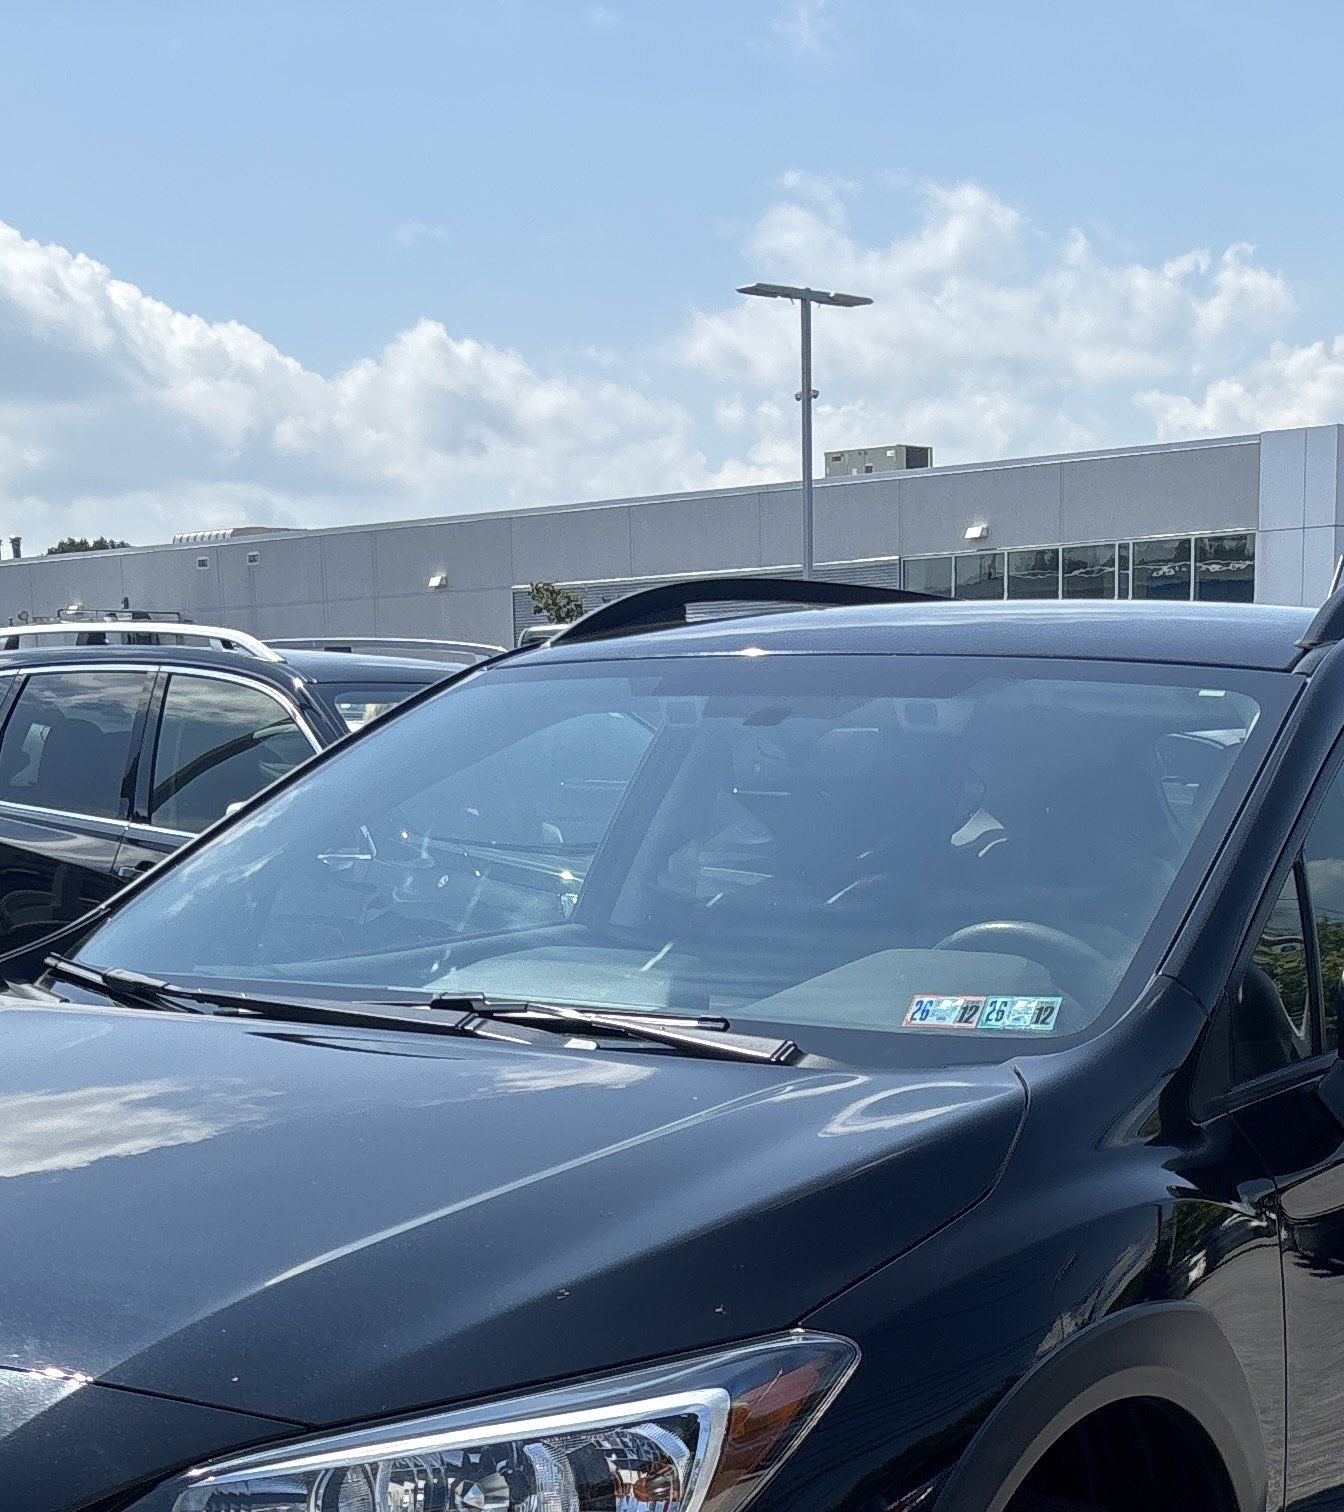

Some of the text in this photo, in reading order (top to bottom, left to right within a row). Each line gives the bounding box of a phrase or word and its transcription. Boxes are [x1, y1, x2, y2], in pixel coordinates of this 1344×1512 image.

[910, 1000, 980, 1024] 26 12
[985, 1000, 1055, 1025] 26 12
